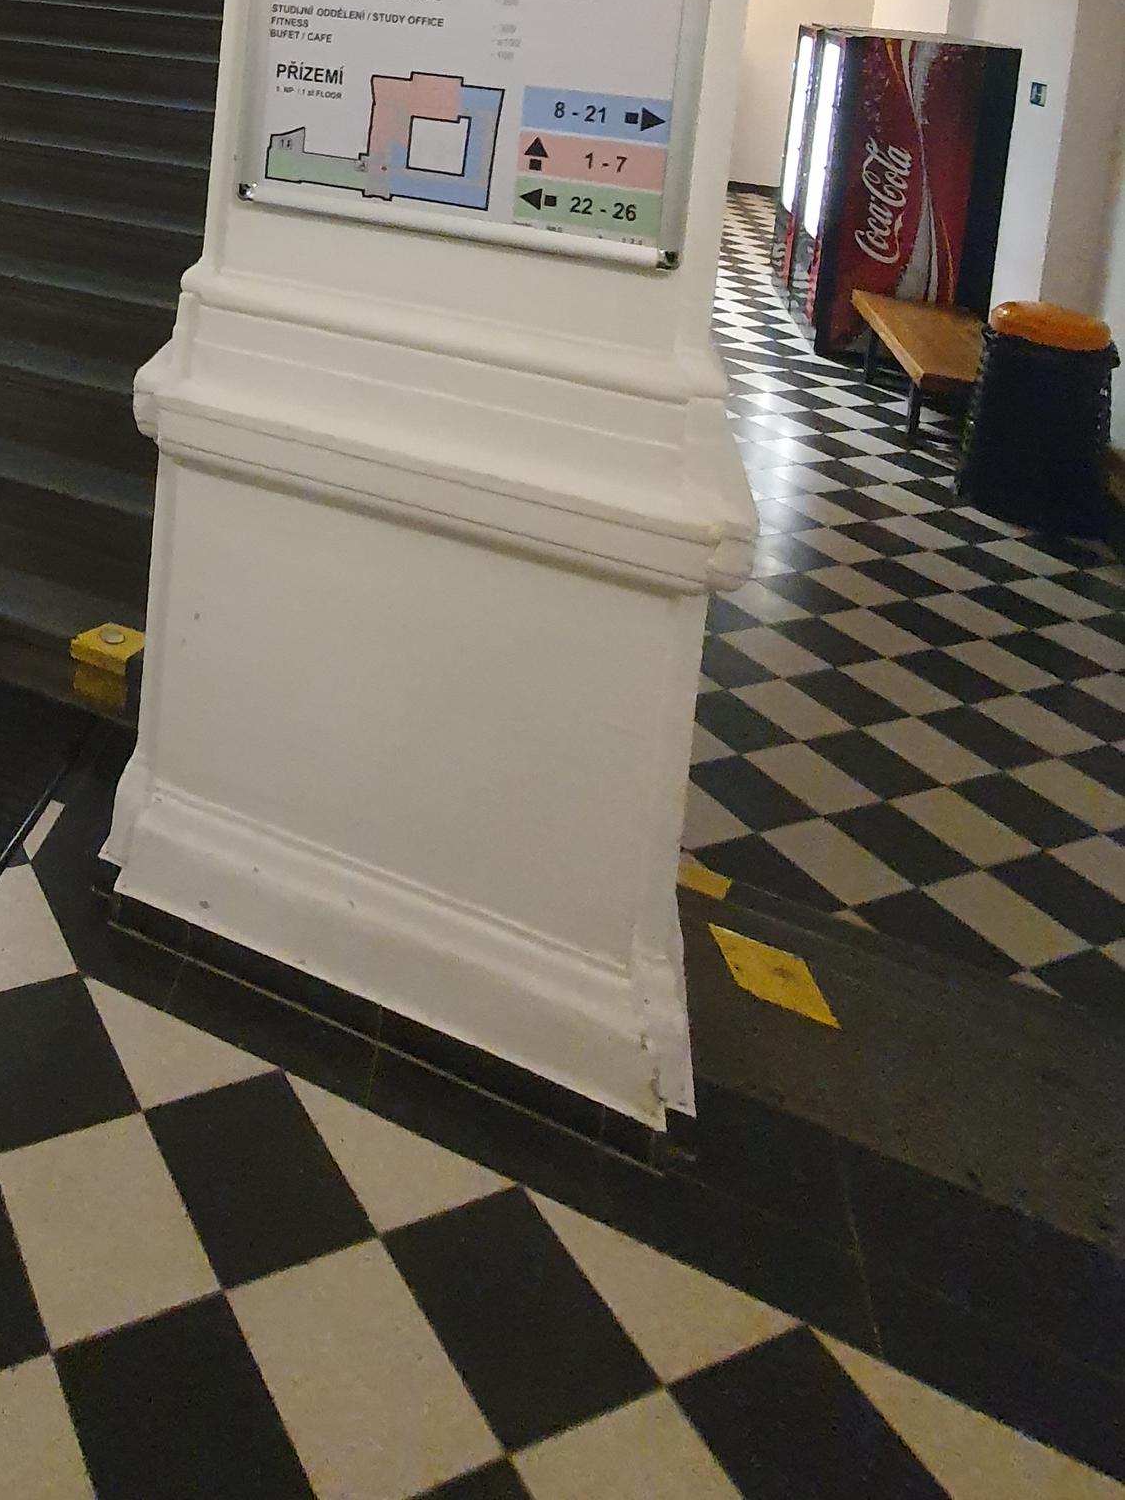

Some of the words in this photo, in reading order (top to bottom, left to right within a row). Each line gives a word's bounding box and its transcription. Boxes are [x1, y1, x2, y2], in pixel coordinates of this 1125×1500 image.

[271, 16, 309, 28] FITNESS
[372, 12, 406, 25] STUDY
[407, 15, 444, 28] OFFICE
[270, 28, 300, 40] BUFET
[276, 61, 344, 85] PŘÍZEMÍ
[554, 101, 565, 118] 8
[584, 105, 607, 123] 21
[585, 152, 594, 169] 1
[617, 156, 627, 173] 7
[569, 196, 593, 215] 22
[612, 202, 637, 221] 26
